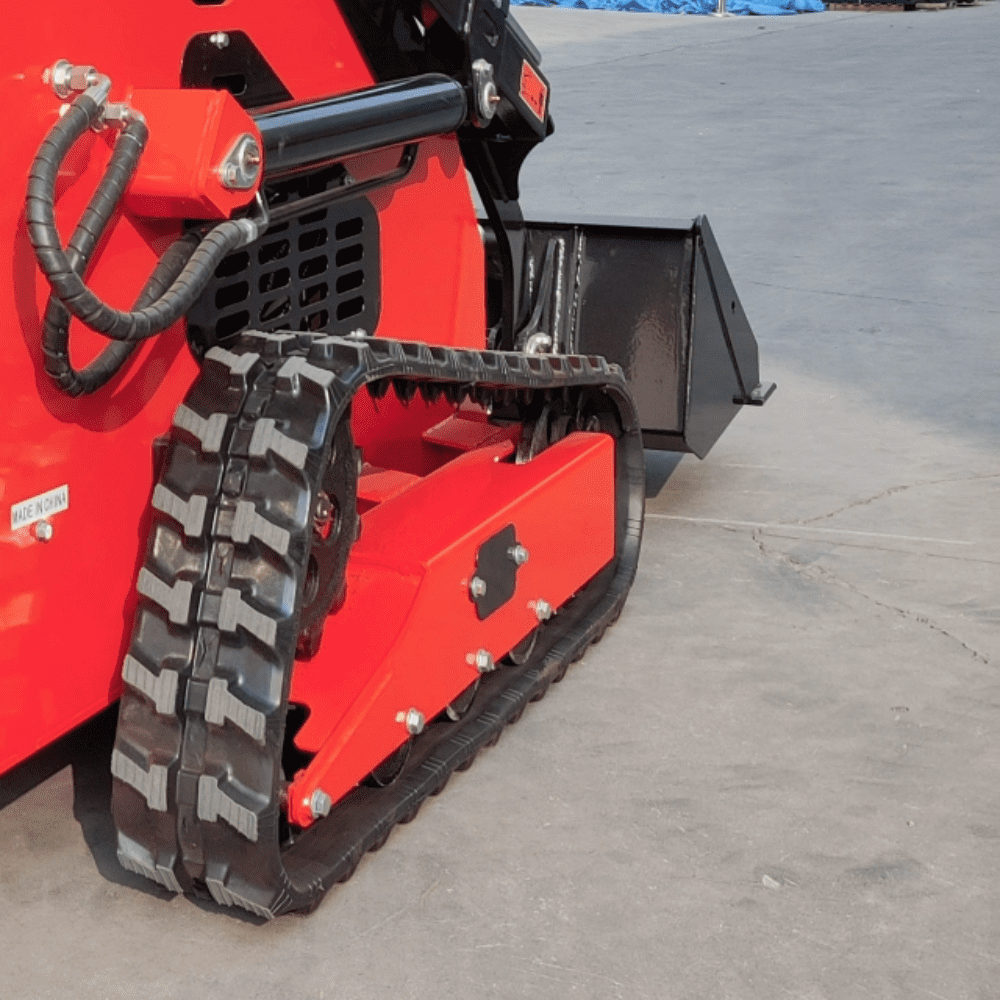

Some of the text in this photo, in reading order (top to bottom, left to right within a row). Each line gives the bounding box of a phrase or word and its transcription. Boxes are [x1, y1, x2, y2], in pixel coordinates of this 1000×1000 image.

[13, 490, 67, 524] MADE IN CHINA
